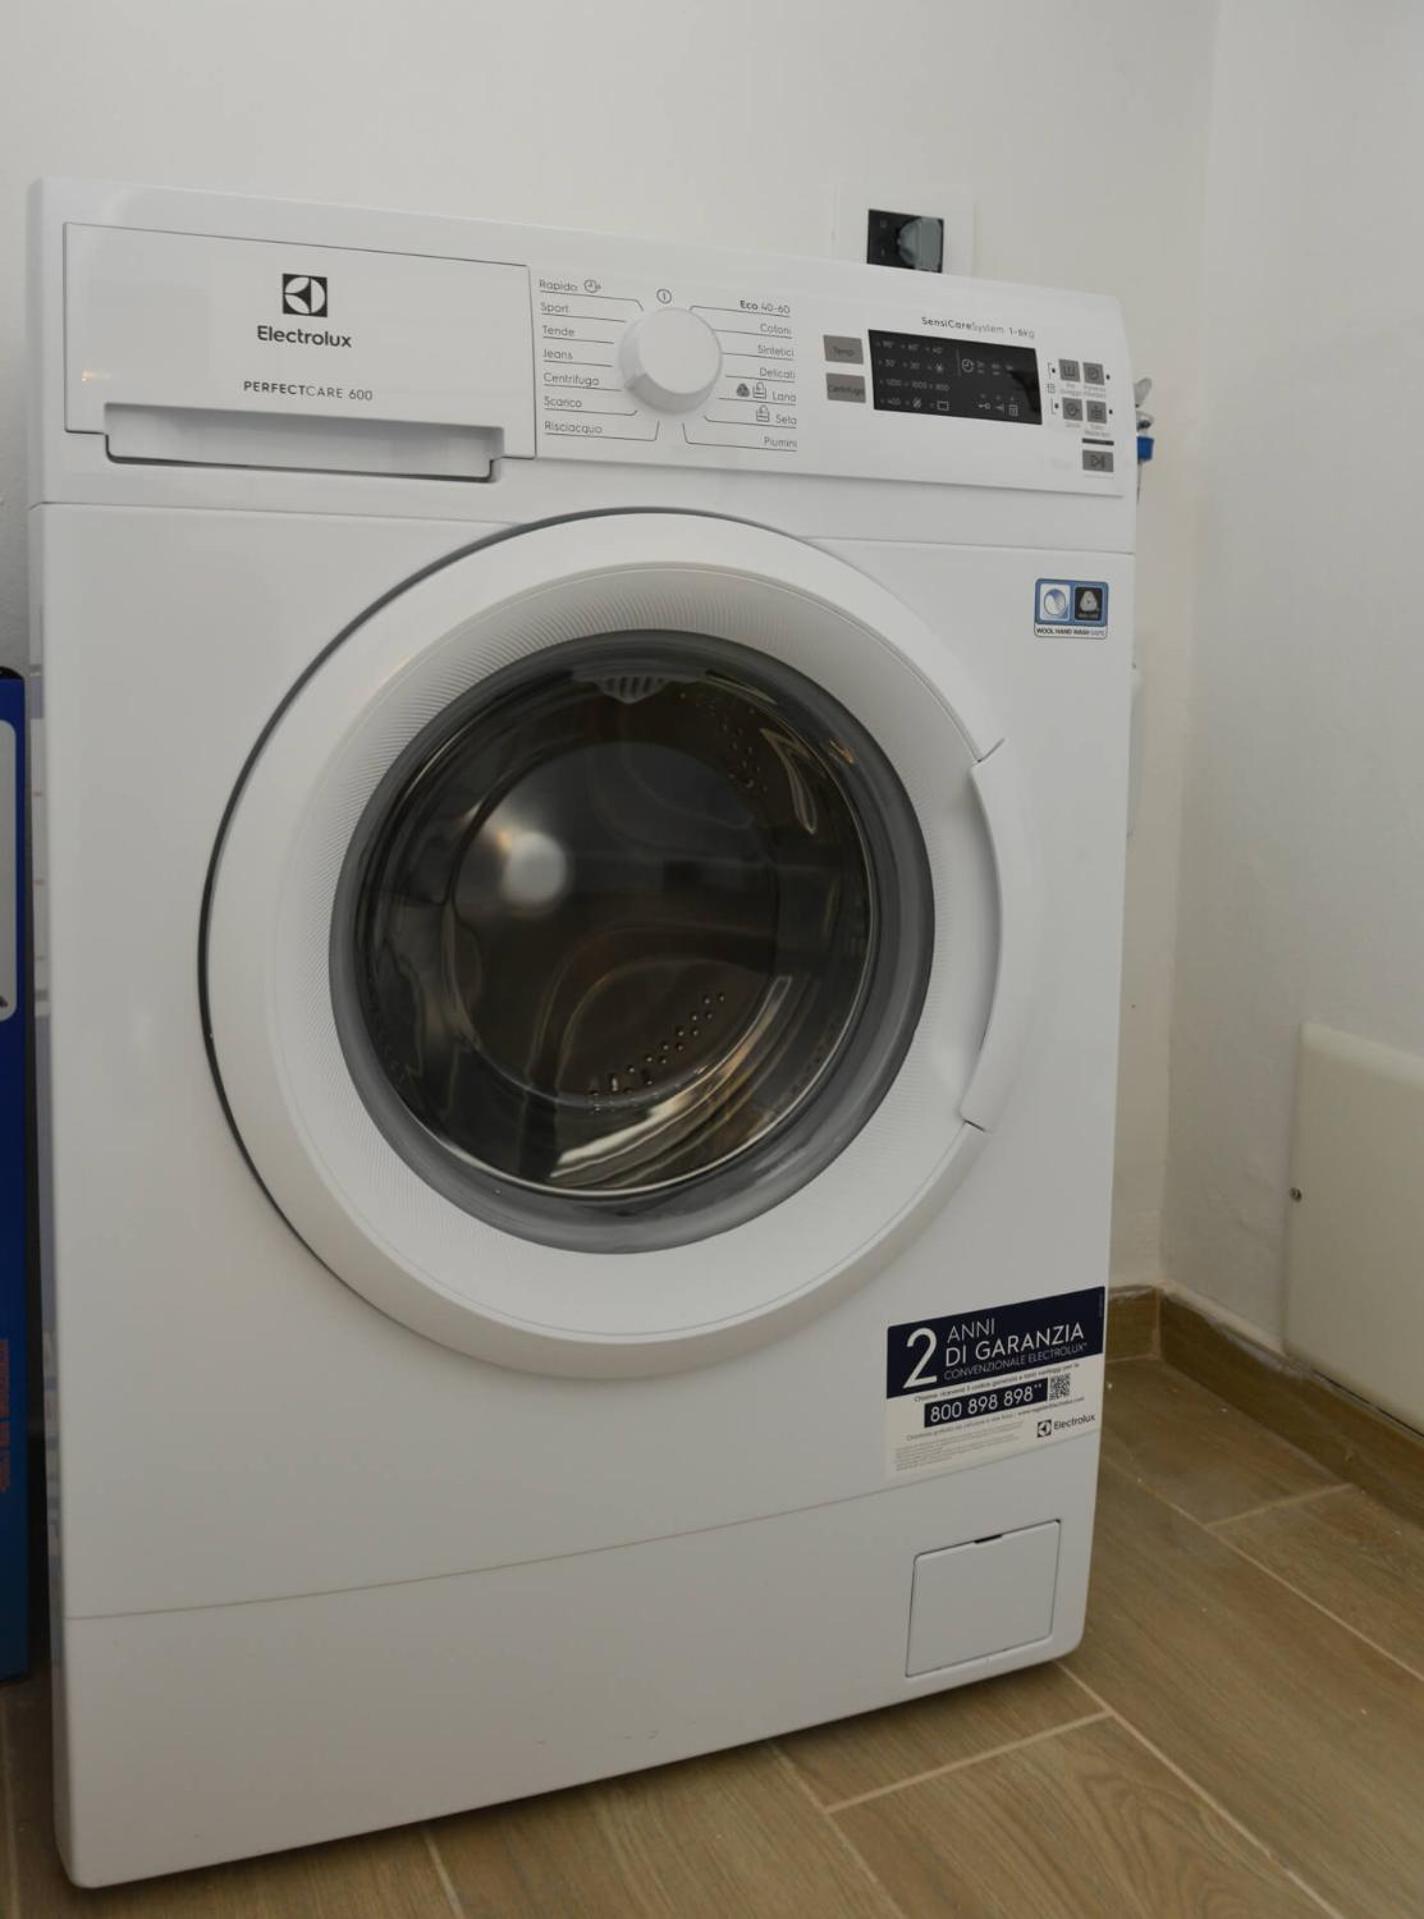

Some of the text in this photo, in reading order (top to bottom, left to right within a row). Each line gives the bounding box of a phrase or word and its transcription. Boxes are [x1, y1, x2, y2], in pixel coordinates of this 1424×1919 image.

[539, 279, 578, 291] Rapido
[540, 302, 569, 313] Sport
[740, 300, 759, 311] Eco
[257, 325, 352, 348] Electrolux
[542, 325, 576, 337] Tende
[543, 348, 574, 360] Jeans
[543, 372, 600, 388] Centrifuga
[243, 380, 374, 401] PERFECTCARE 600
[544, 420, 603, 434] Risciacquo
[947, 1318, 995, 1344] ANNI
[945, 1321, 1084, 1367] DI GARANZIA
[903, 1327, 938, 1389] 2
[943, 1355, 1026, 1380] CONVENZIONALE
[930, 1401, 962, 1423] 800
[968, 1393, 998, 1415] 898
[1053, 1414, 1096, 1430] Electrolux
